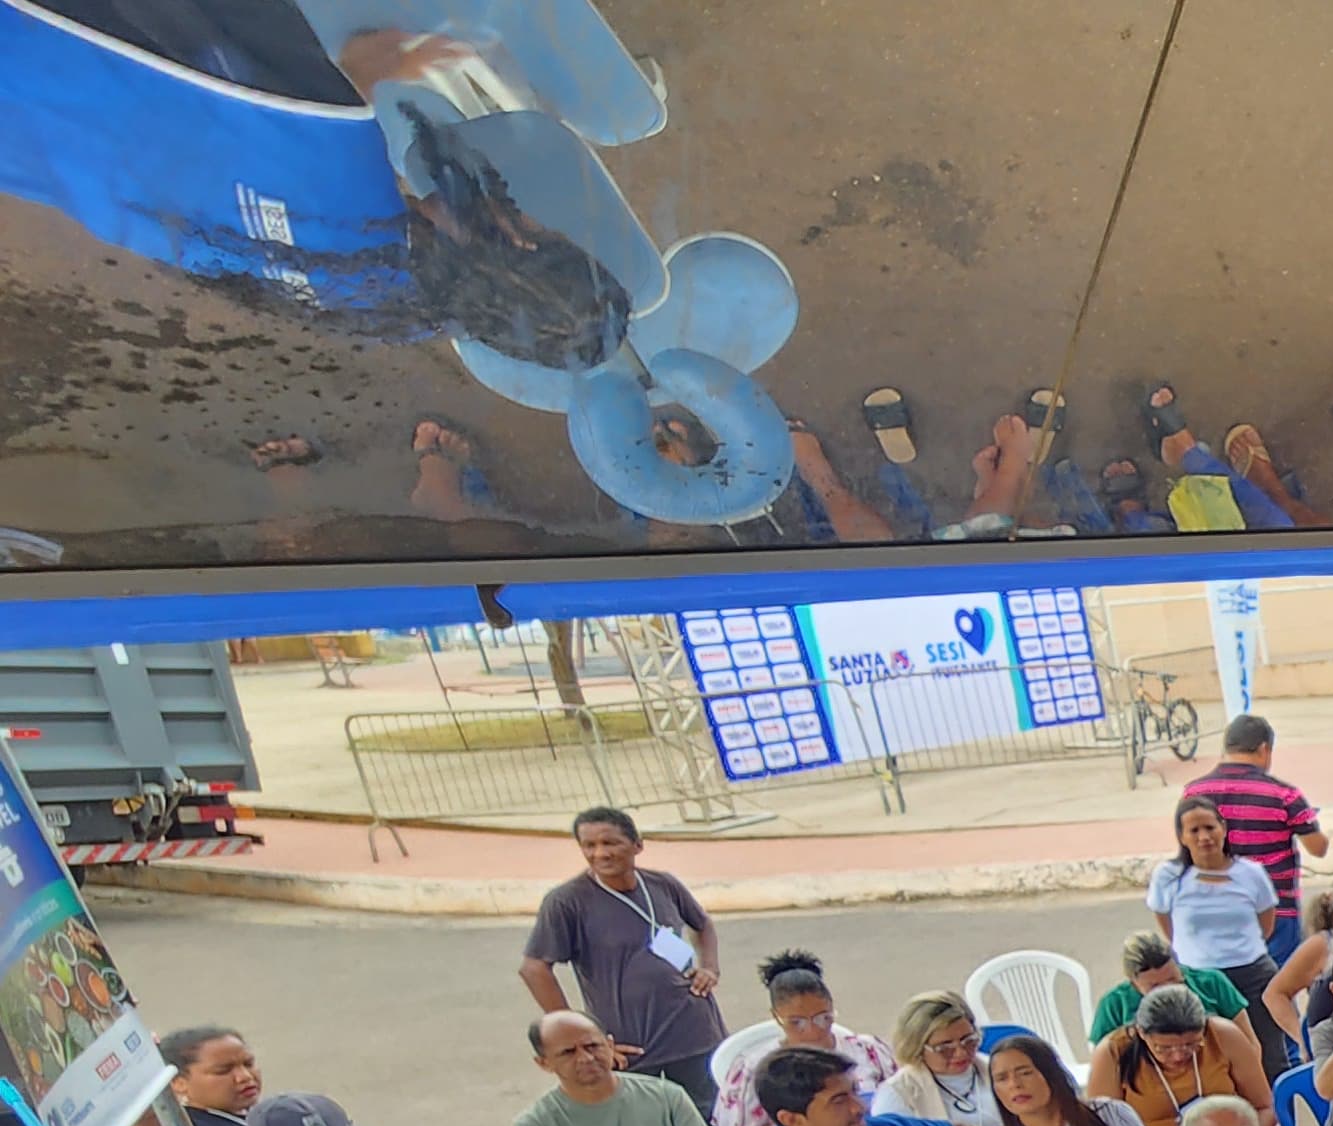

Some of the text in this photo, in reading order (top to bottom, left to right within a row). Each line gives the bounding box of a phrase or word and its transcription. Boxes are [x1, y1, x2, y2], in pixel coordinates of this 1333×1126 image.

[828, 652, 886, 672] SANTA
[925, 641, 967, 664] SESI
[841, 667, 892, 687] LUZIA
